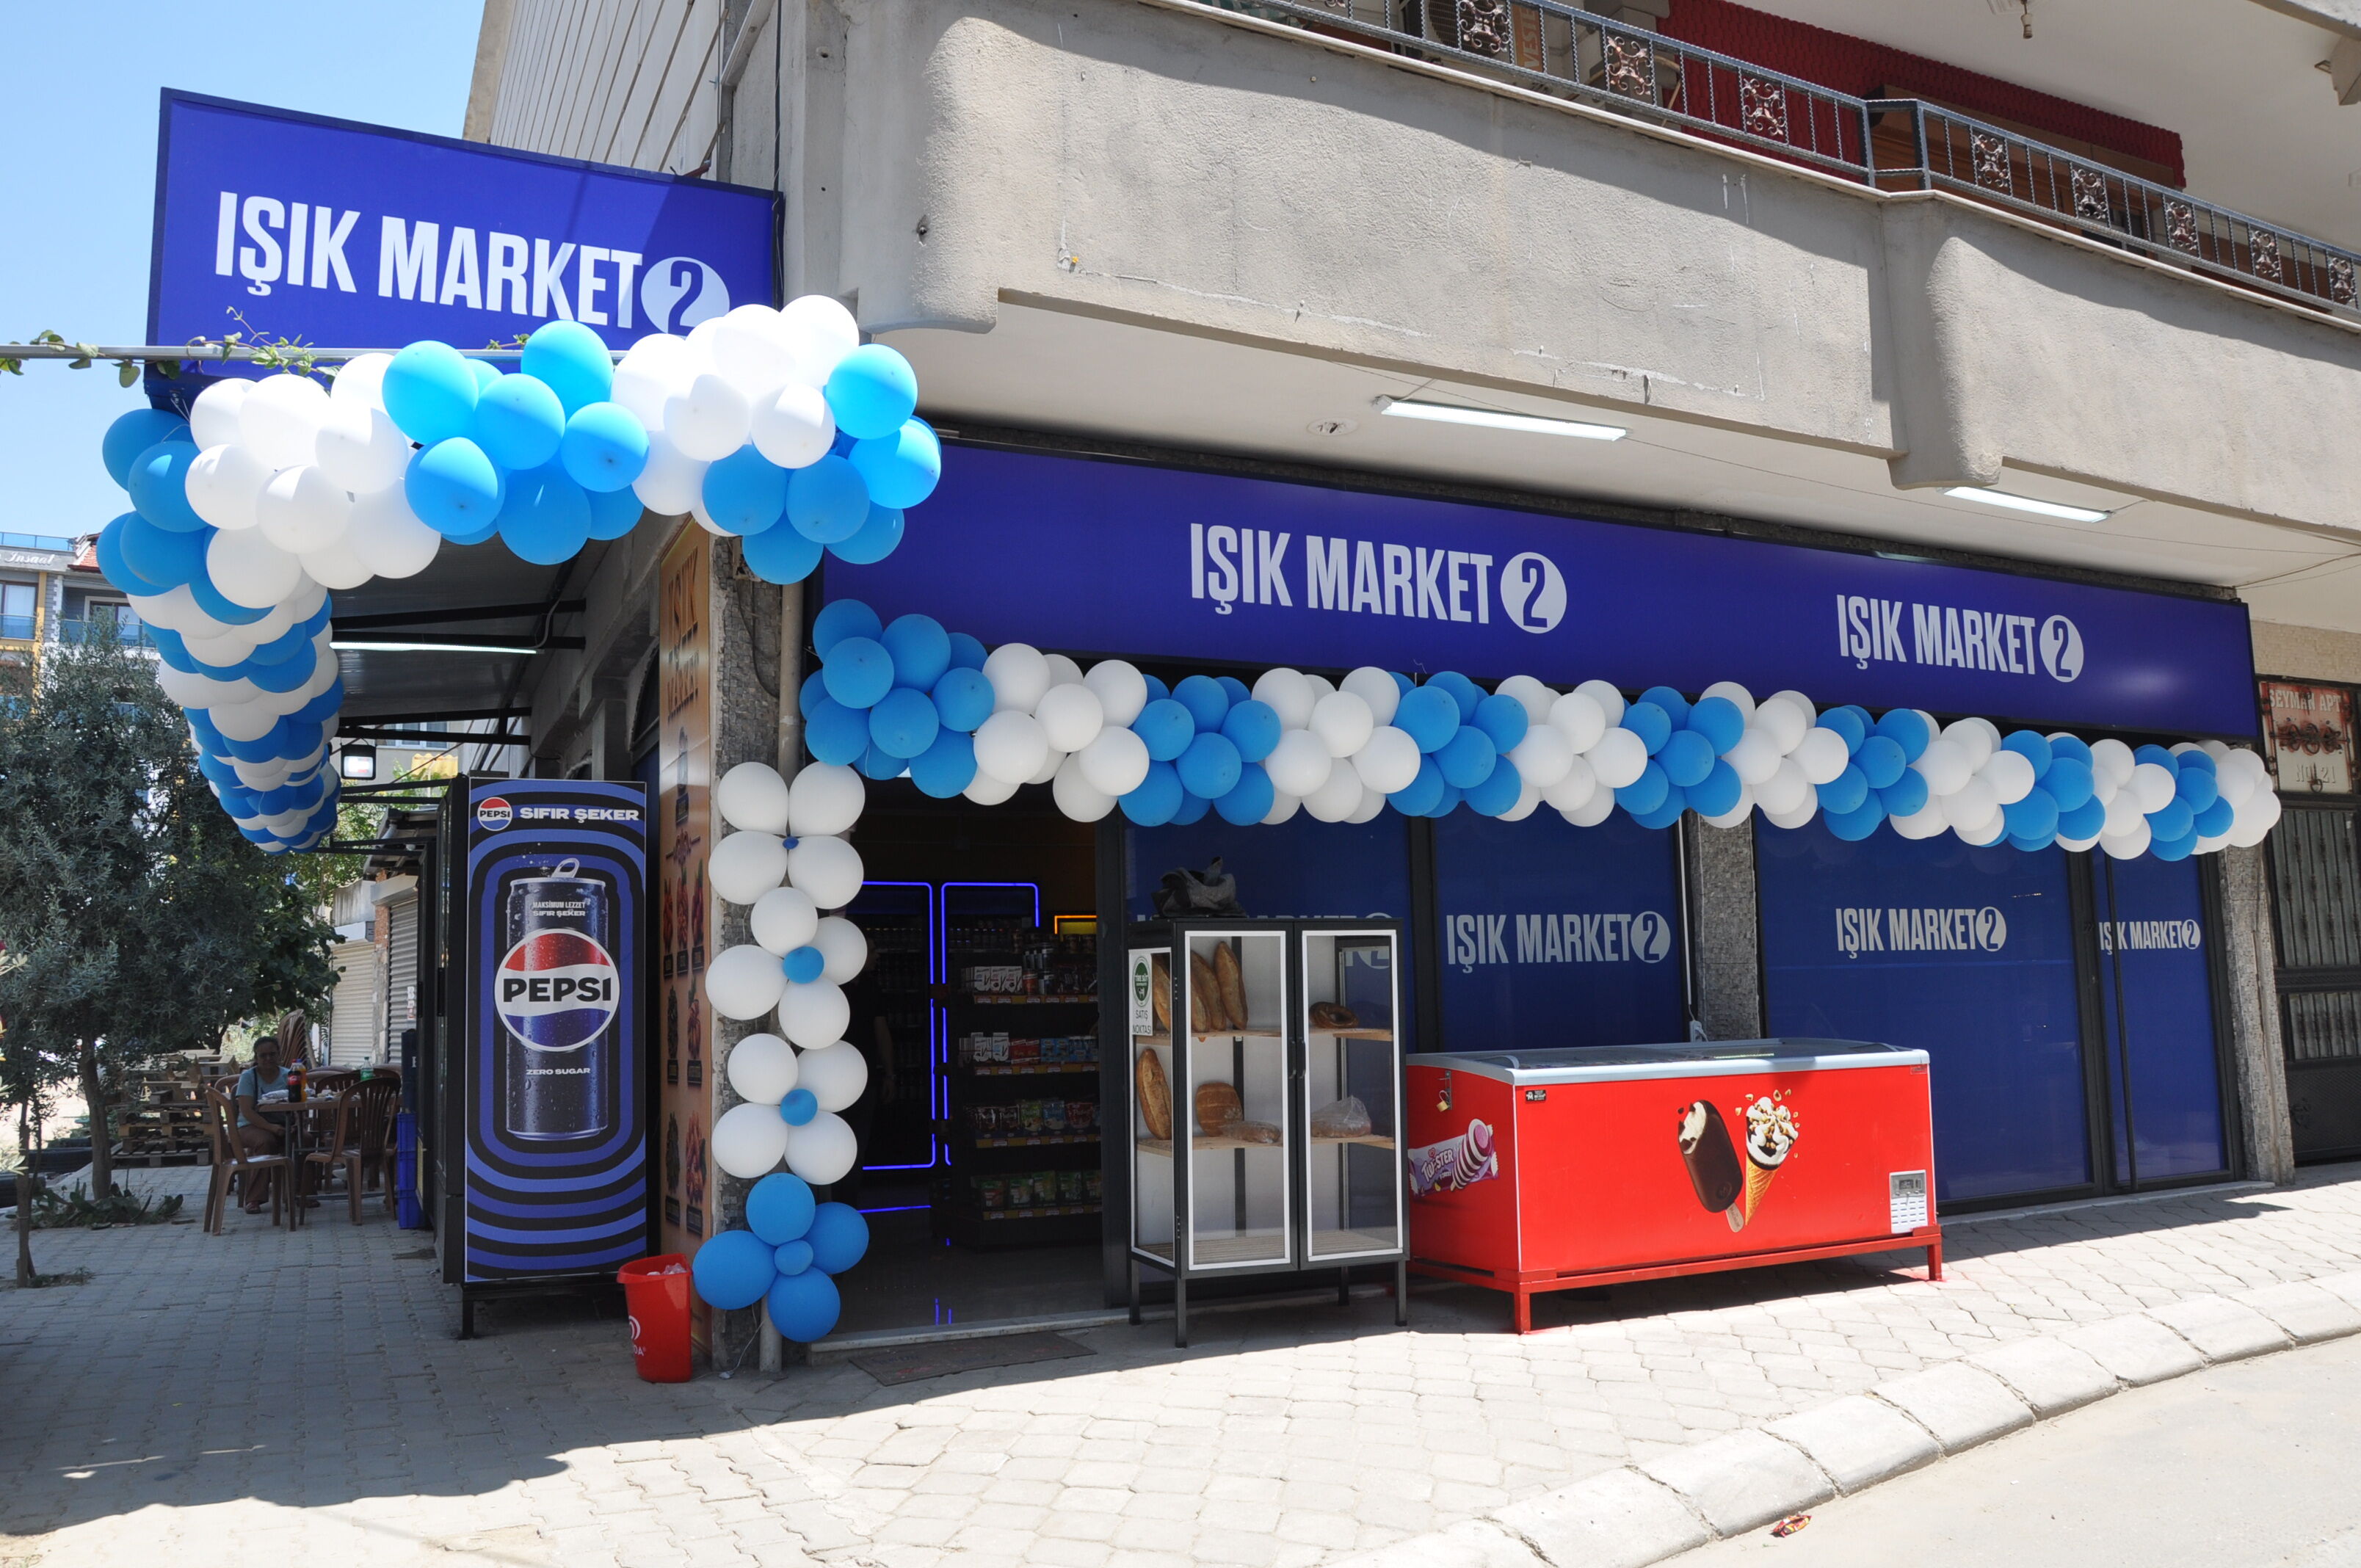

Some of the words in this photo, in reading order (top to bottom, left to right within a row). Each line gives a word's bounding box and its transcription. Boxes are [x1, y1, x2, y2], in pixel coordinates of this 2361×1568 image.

[1520, 7, 1539, 68] VESTE
[216, 191, 360, 297] IŞIK
[378, 215, 643, 330] MARKET
[667, 260, 703, 336] 2
[1190, 522, 1293, 615] IŞIK
[1306, 534, 1493, 624] MARKET
[1521, 557, 1548, 629] 2
[1837, 595, 1907, 669] IŞIK
[1912, 603, 2035, 675] MARKET
[2052, 620, 2072, 678] 2
[520, 807, 569, 820] SIFIR
[574, 808, 639, 824] ŞEKER
[1446, 914, 1509, 973] IŞIK
[1516, 914, 1631, 963] MARKET
[1643, 913, 1660, 961] 2
[1835, 908, 1885, 959] IŞIK
[1888, 909, 1976, 951] MARKET
[1984, 909, 1999, 950] 2
[2099, 921, 2128, 955] IŞK
[2130, 921, 2183, 949] MARKET
[503, 977, 612, 1003] PEPSI
